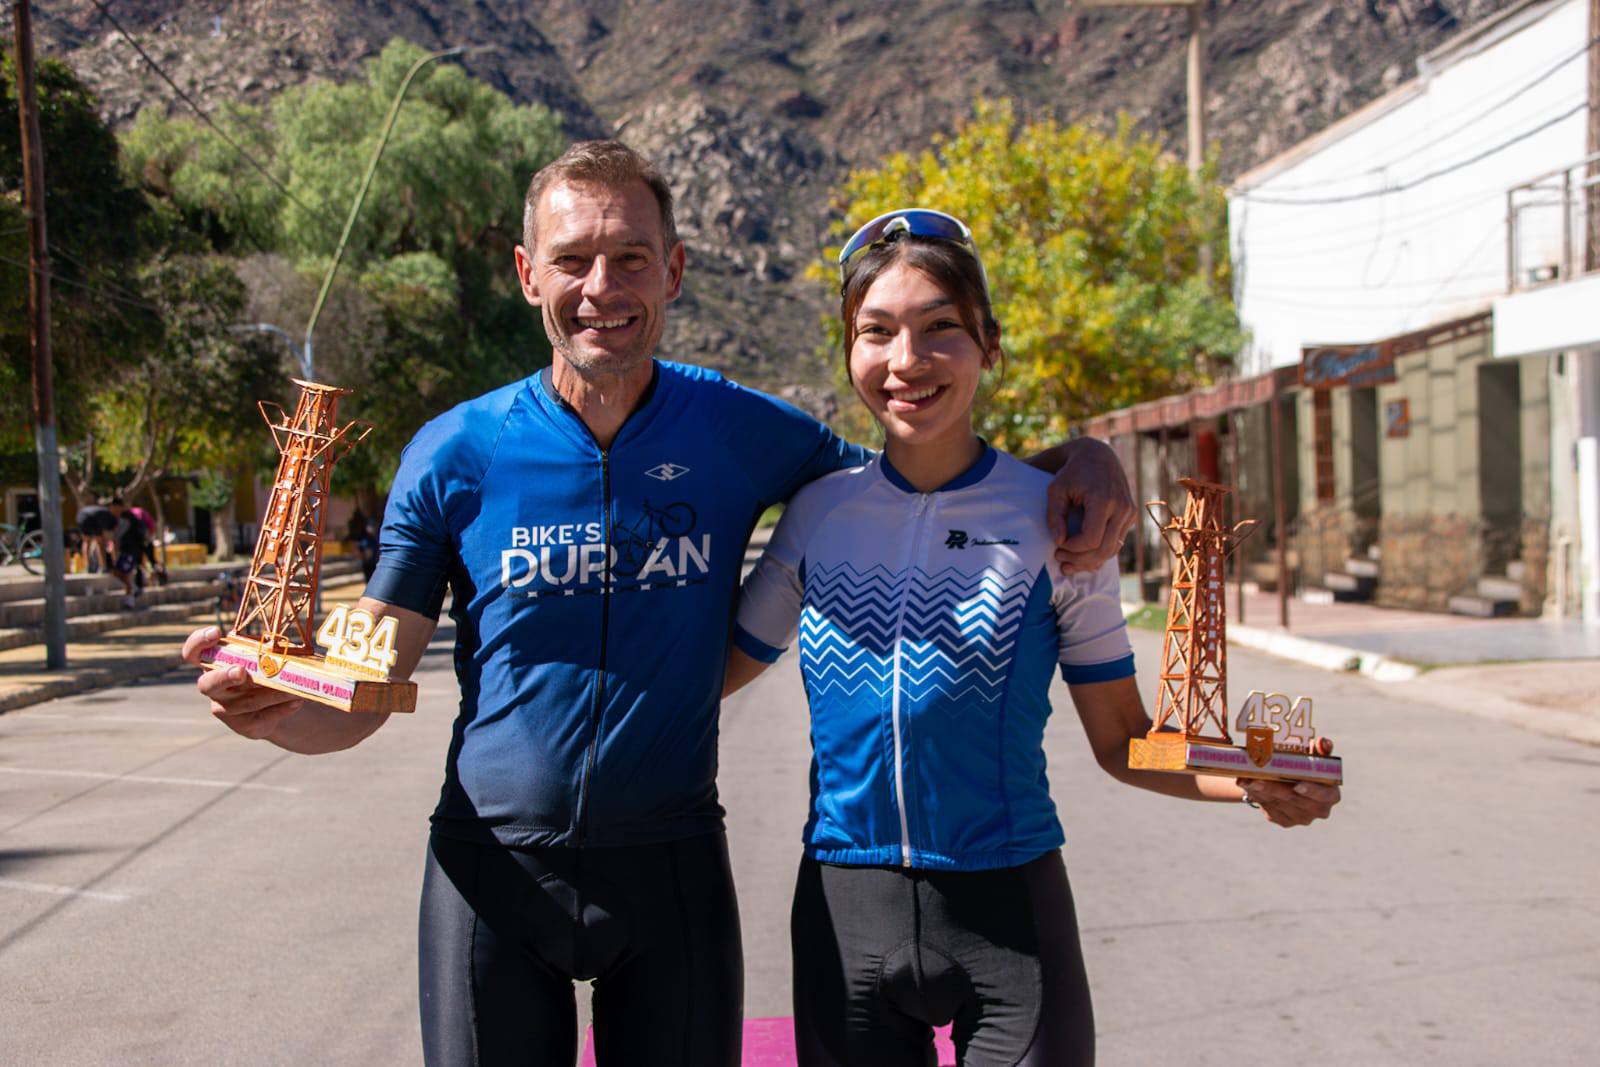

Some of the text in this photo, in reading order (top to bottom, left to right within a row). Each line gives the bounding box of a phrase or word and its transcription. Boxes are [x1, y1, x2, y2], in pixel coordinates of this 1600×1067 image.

[511, 522, 602, 547] BIKE'S
[1208, 555, 1219, 651] FAMATINA
[316, 603, 398, 677] 434
[1235, 690, 1316, 747] 434
